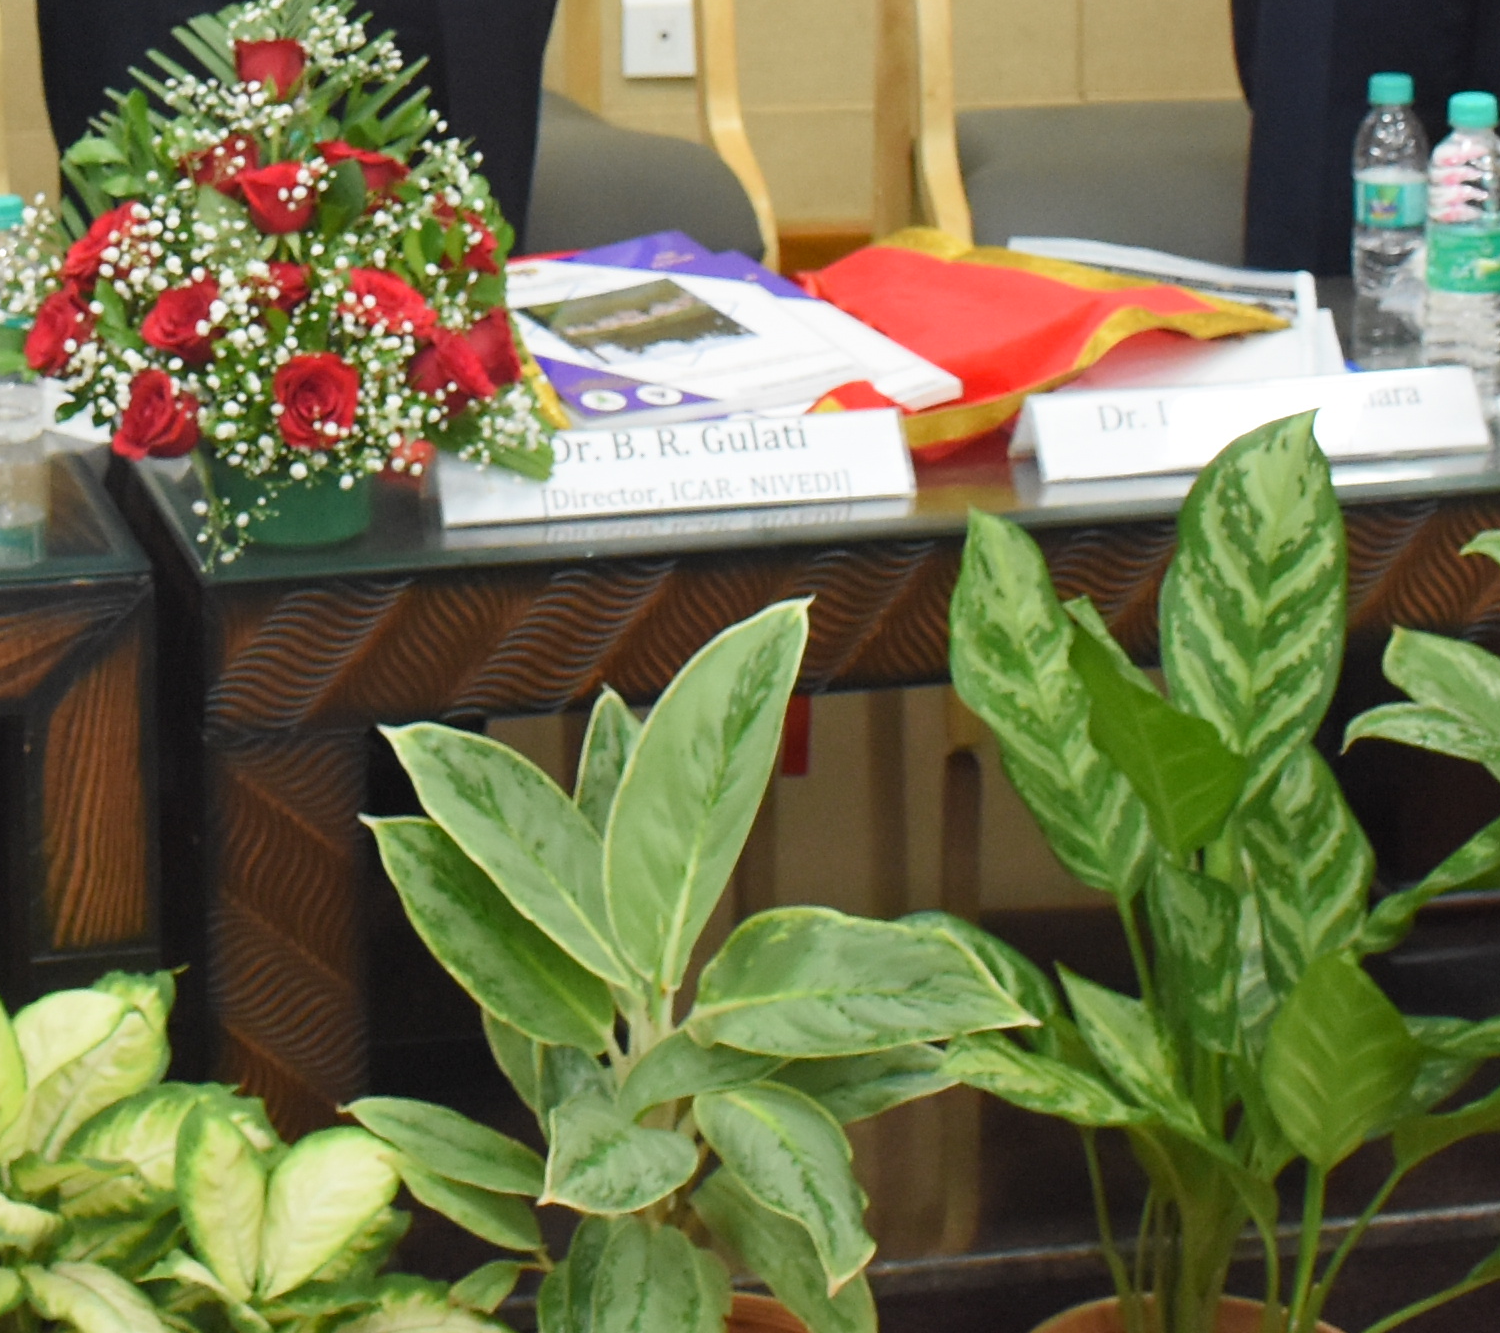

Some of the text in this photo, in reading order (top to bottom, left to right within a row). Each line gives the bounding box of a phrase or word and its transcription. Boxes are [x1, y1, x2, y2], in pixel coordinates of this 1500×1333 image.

[1098, 404, 1147, 432] Dr.
[549, 420, 808, 465] Dr. B. R. Gulati
[540, 468, 853, 519] [Director, ICAR- NIVEDI]
